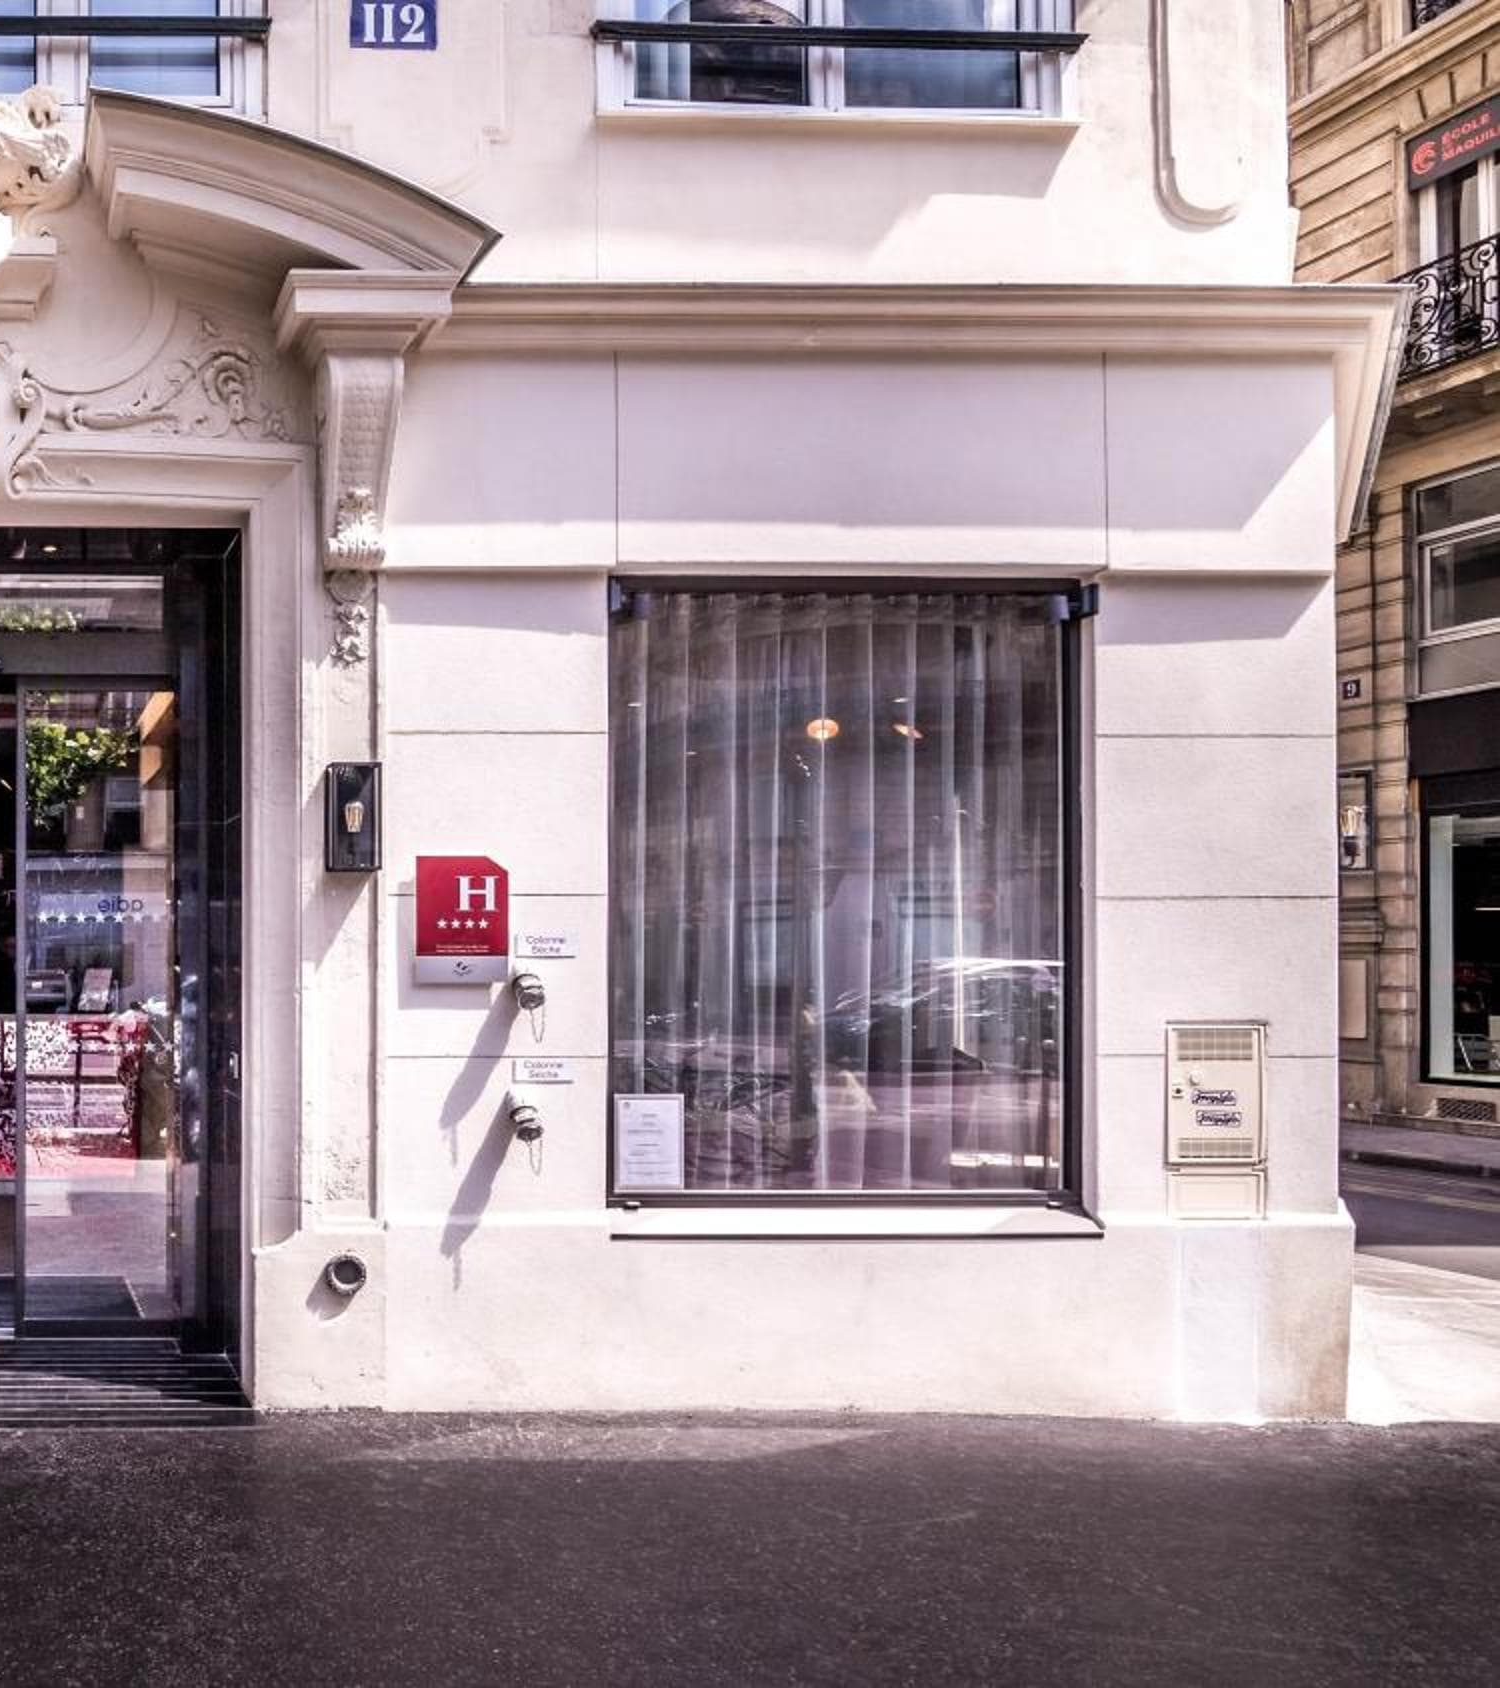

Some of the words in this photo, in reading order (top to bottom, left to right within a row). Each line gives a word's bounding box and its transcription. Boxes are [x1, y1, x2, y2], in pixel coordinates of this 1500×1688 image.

[363, 3, 425, 43] 112
[1443, 125, 1500, 160] MAQUIL
[1346, 682, 1357, 695] 9
[457, 875, 499, 912] H
